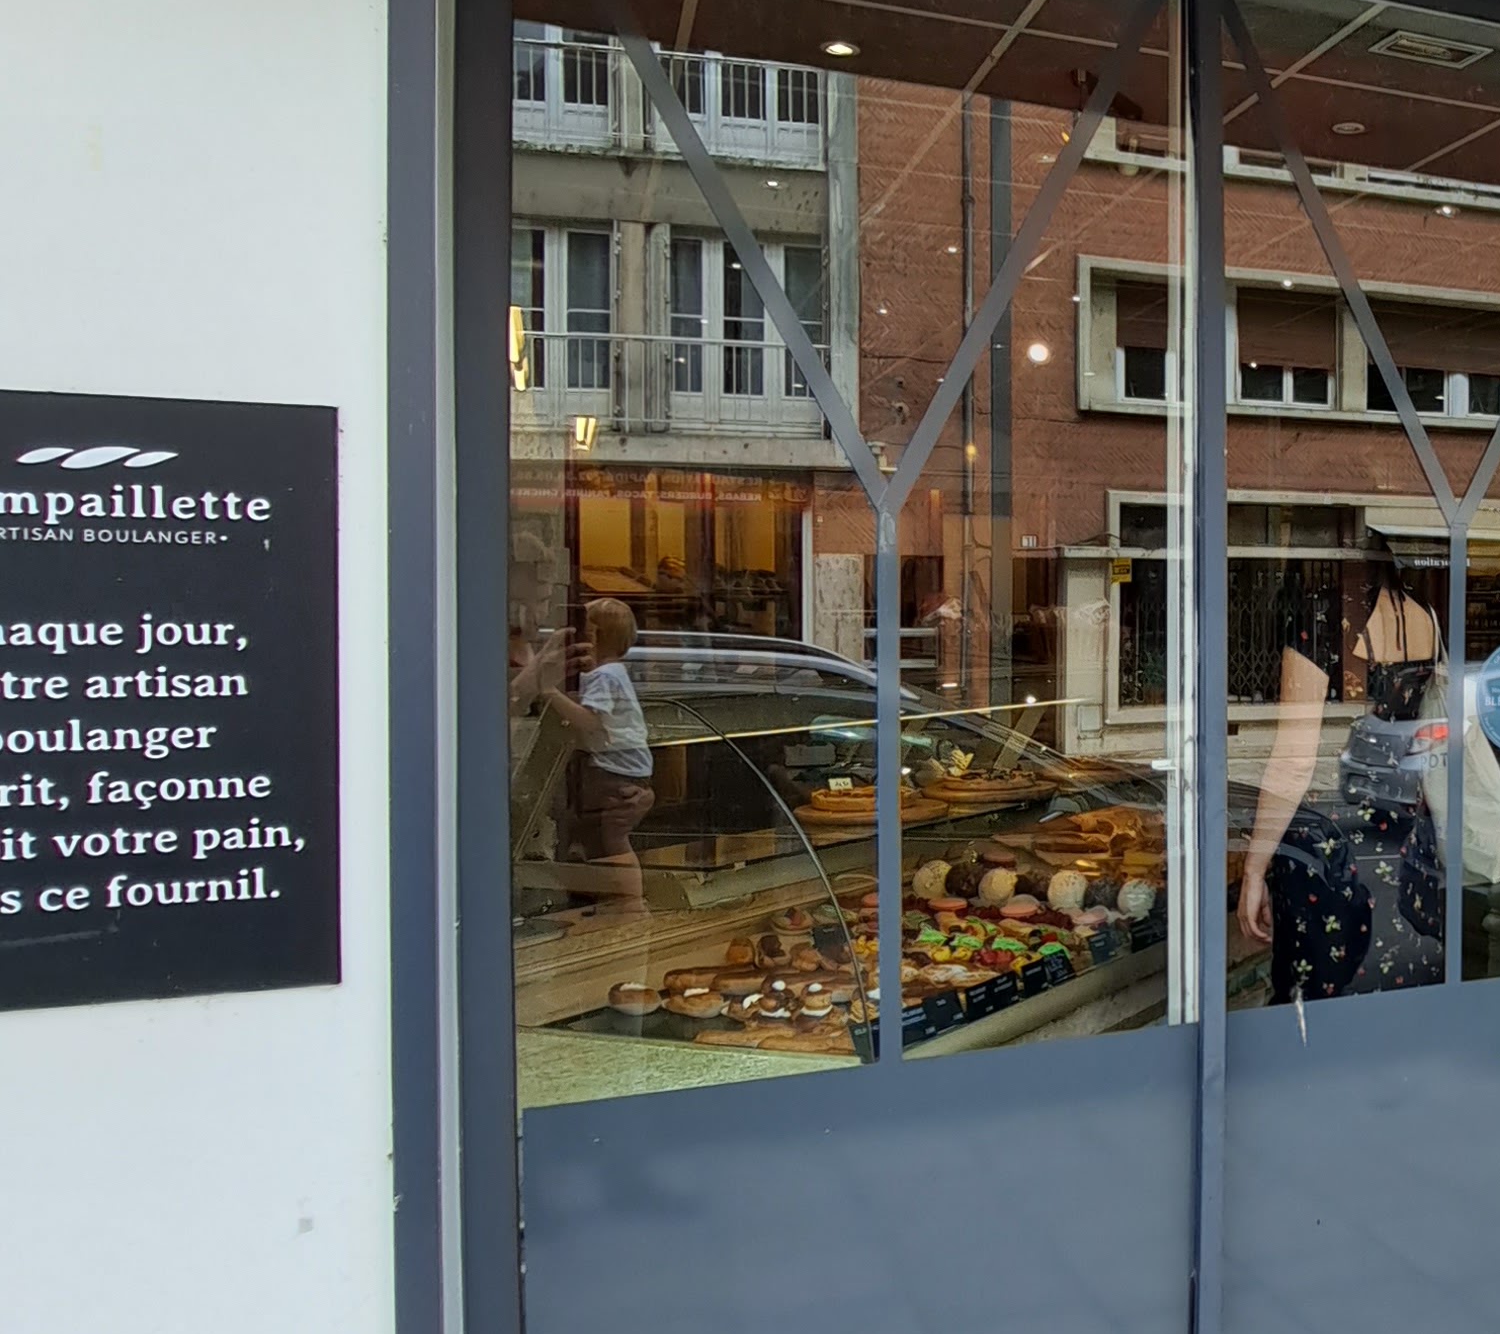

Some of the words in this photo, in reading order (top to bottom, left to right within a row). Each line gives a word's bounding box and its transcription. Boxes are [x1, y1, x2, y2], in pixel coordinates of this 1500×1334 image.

[83, 528, 218, 545] BOULANGER
[136, 613, 248, 653] jour,
[85, 669, 248, 699] artisan
[87, 771, 272, 809] façonne
[52, 827, 178, 857] votre
[192, 818, 305, 860] pain,
[39, 886, 90, 912] ce
[106, 868, 280, 908] fournil.
